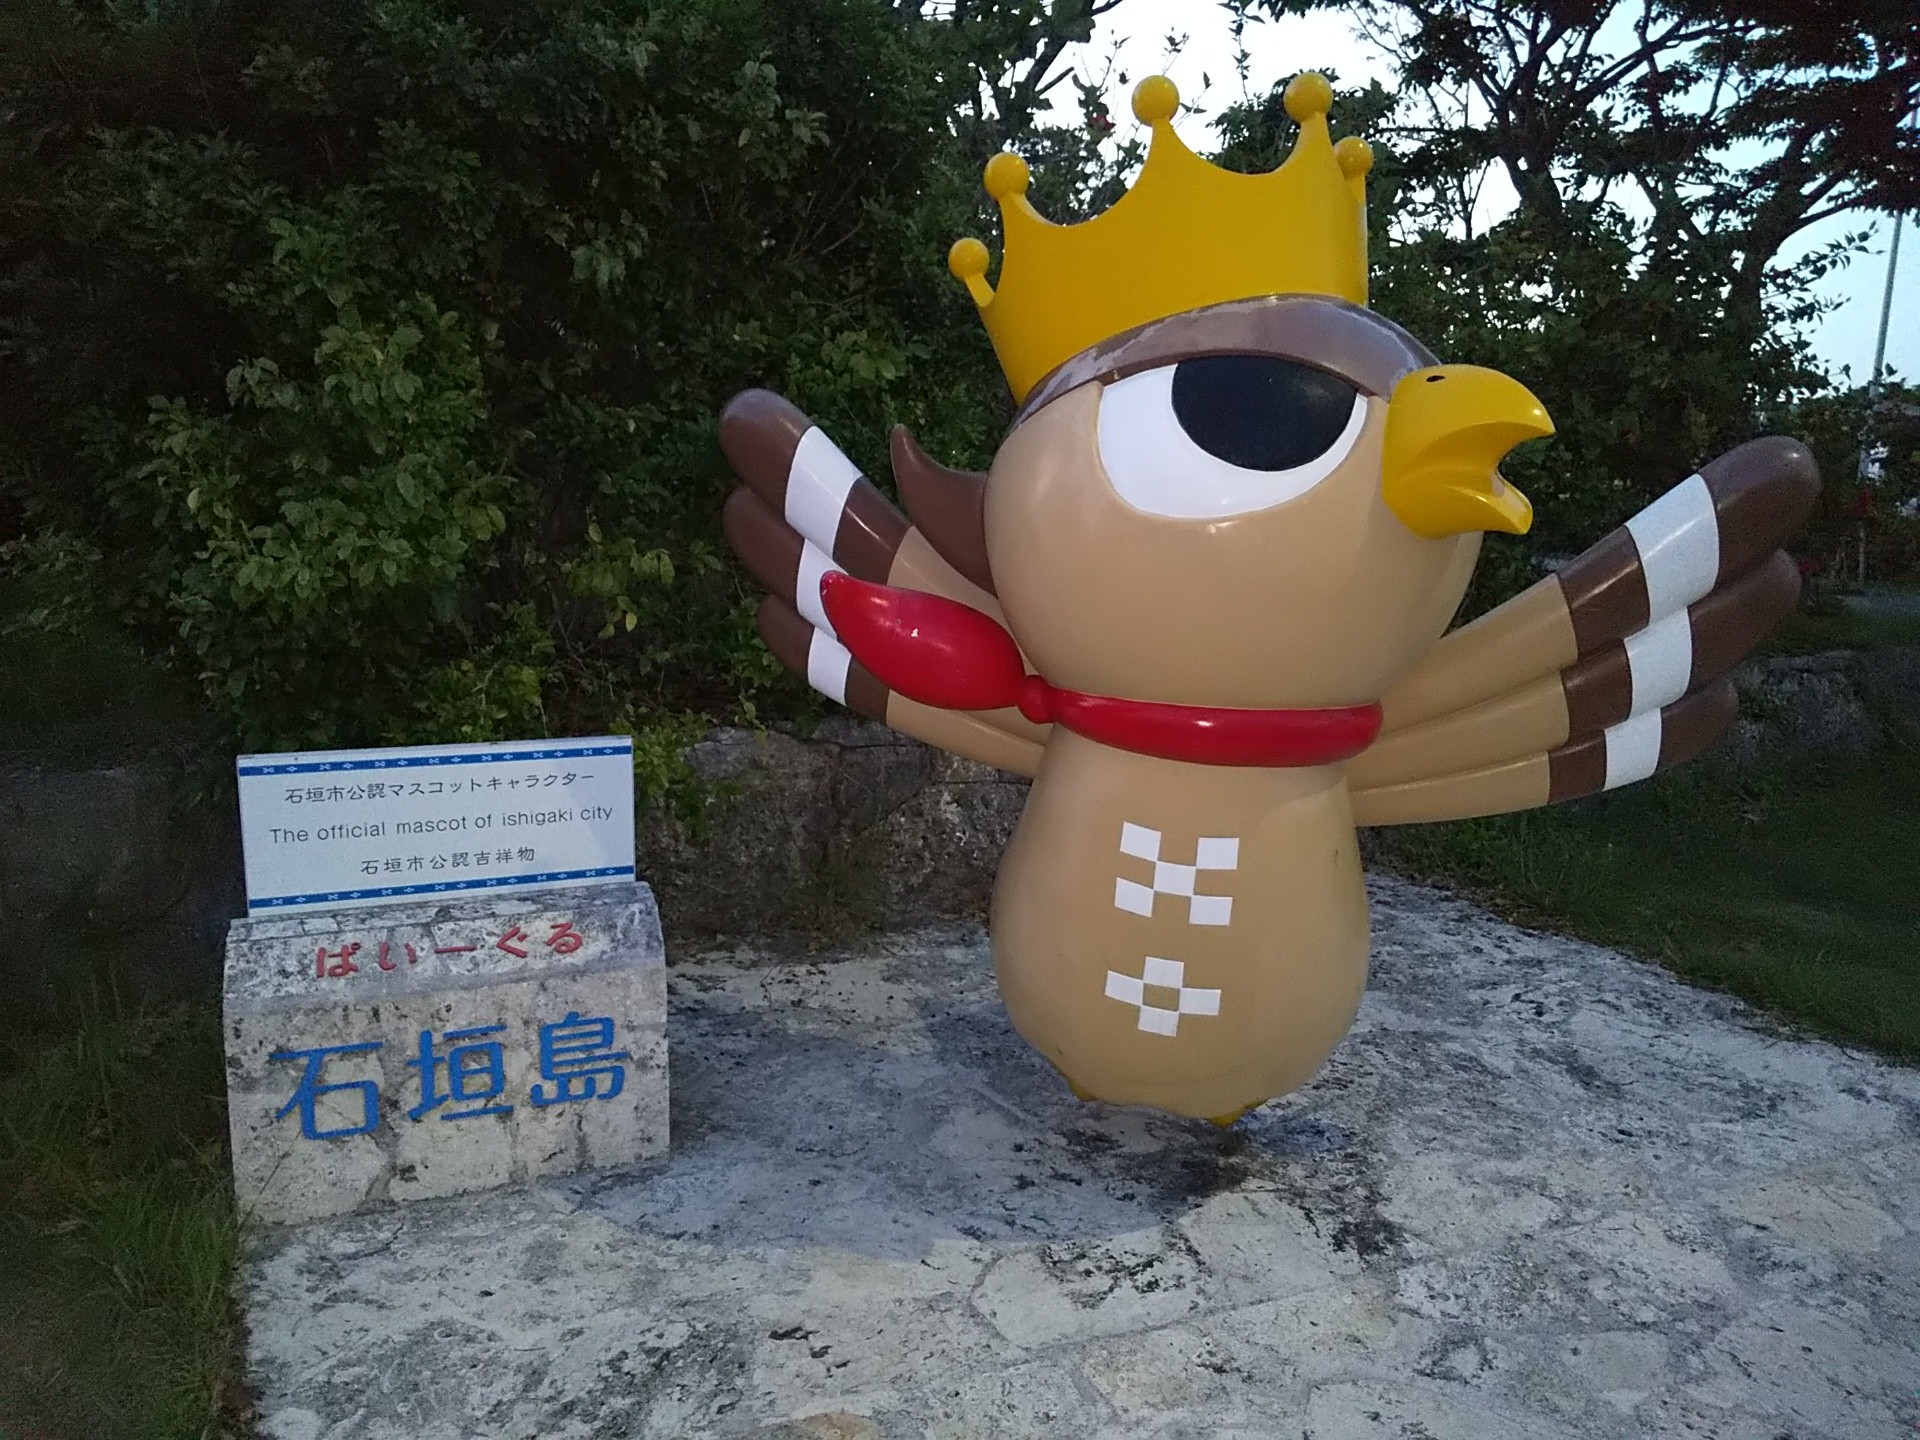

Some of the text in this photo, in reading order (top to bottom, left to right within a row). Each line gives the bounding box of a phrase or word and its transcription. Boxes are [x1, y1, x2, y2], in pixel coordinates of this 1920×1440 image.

[284, 771, 595, 804] 石垣市公認マスコットキャラクター
[269, 805, 613, 844] The official mascot of ishigaki city
[360, 847, 535, 875] 石垣市公認吉祥物
[316, 922, 583, 978] ぱいーぐる
[272, 1011, 630, 1141] 石垣島
